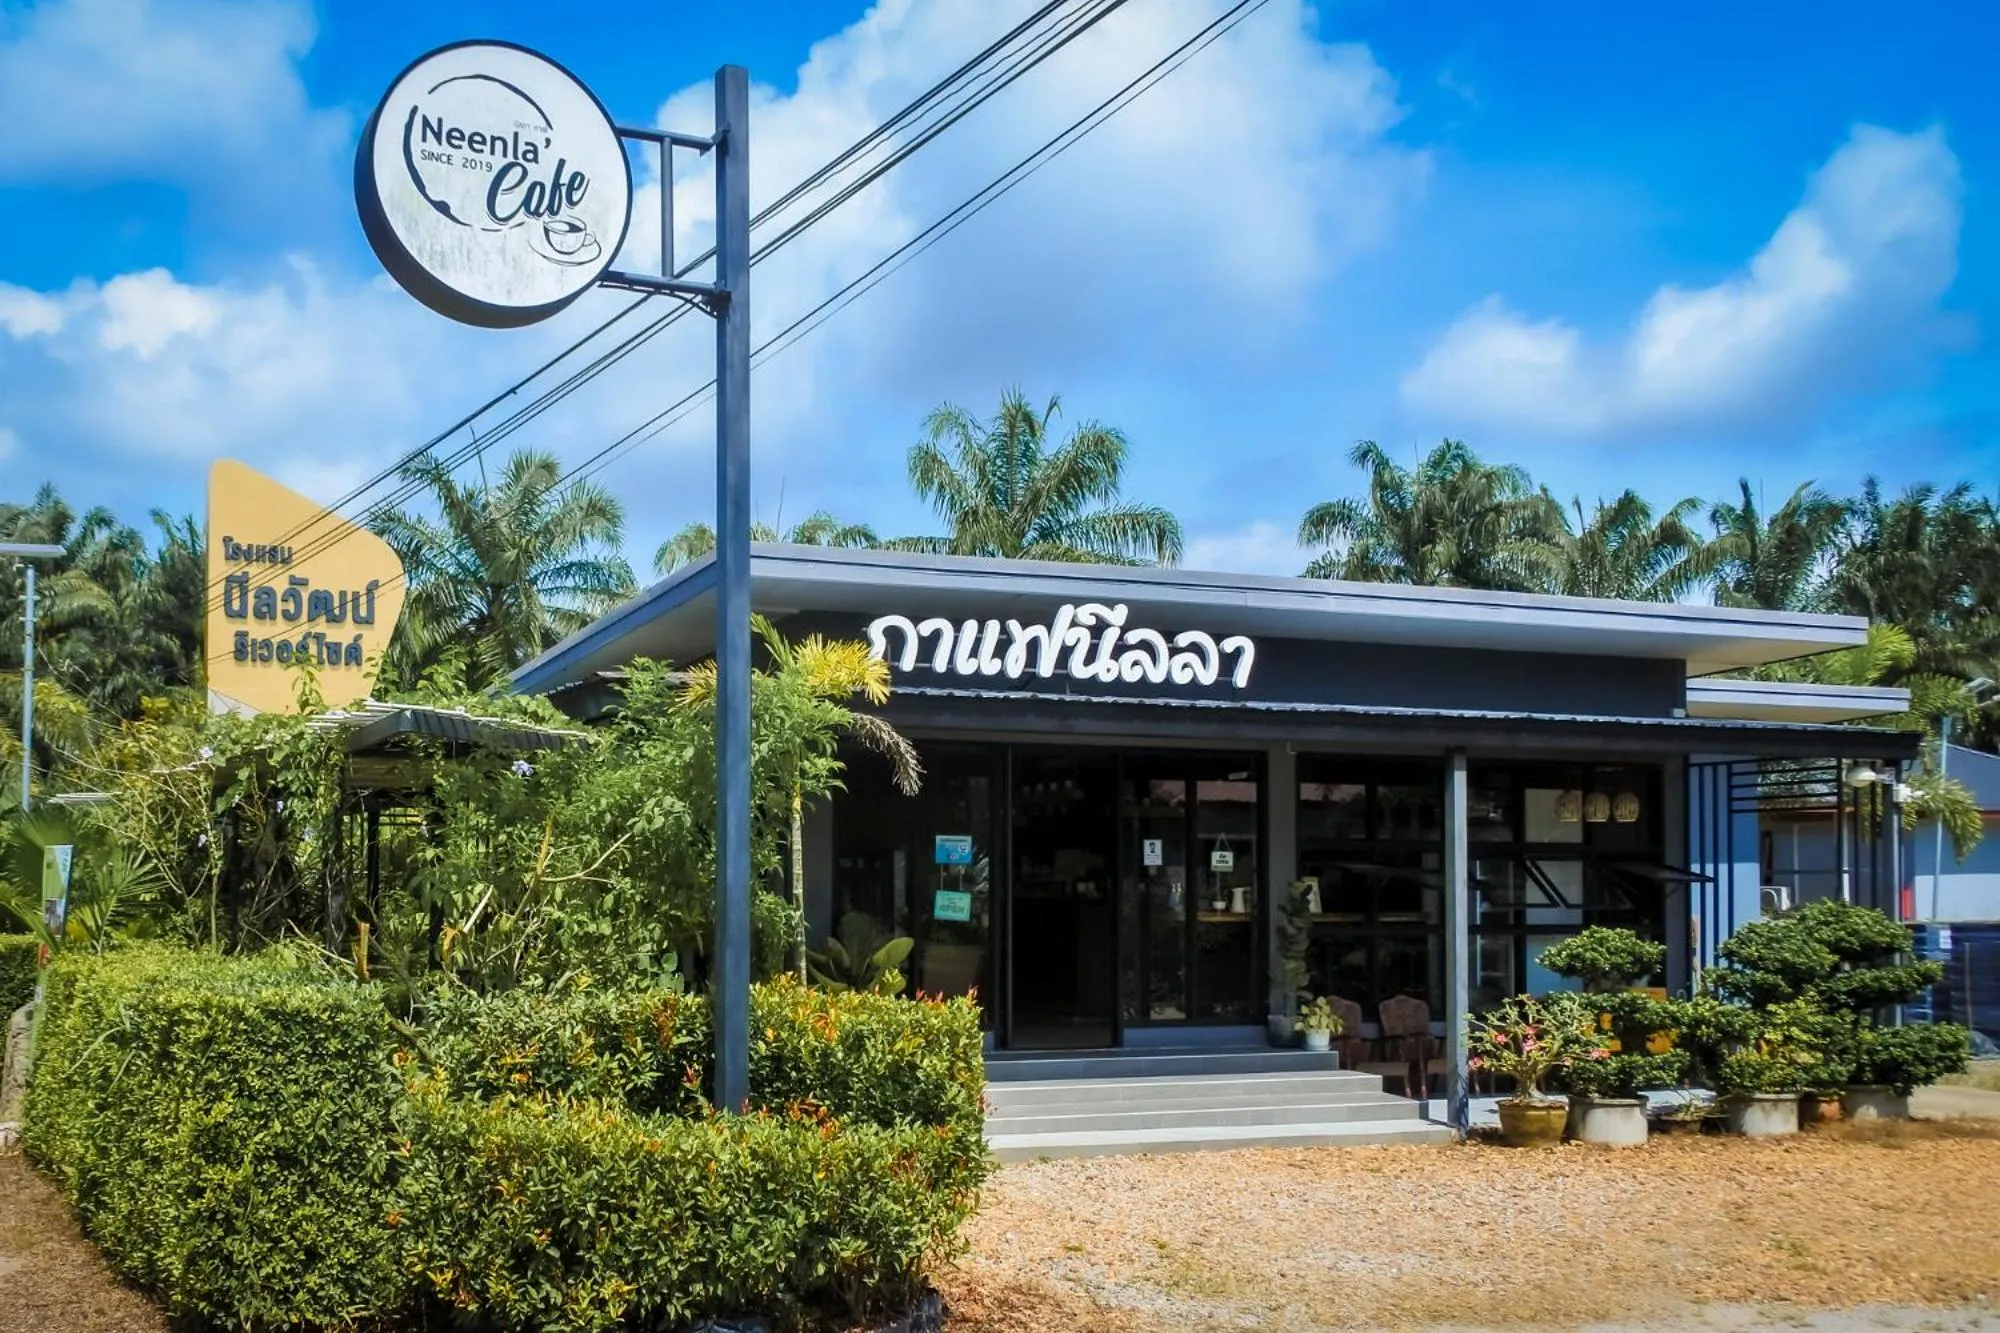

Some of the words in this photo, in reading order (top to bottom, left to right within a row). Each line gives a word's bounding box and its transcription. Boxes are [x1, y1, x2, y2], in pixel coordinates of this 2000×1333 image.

[420, 149, 454, 166] SINCE
[461, 156, 493, 173] 2019
[486, 158, 590, 225] Cafe
[222, 535, 294, 564] โรงแรม
[223, 571, 379, 625] นีลวัฒน์
[867, 603, 1255, 688] กาแฟนีลลา
